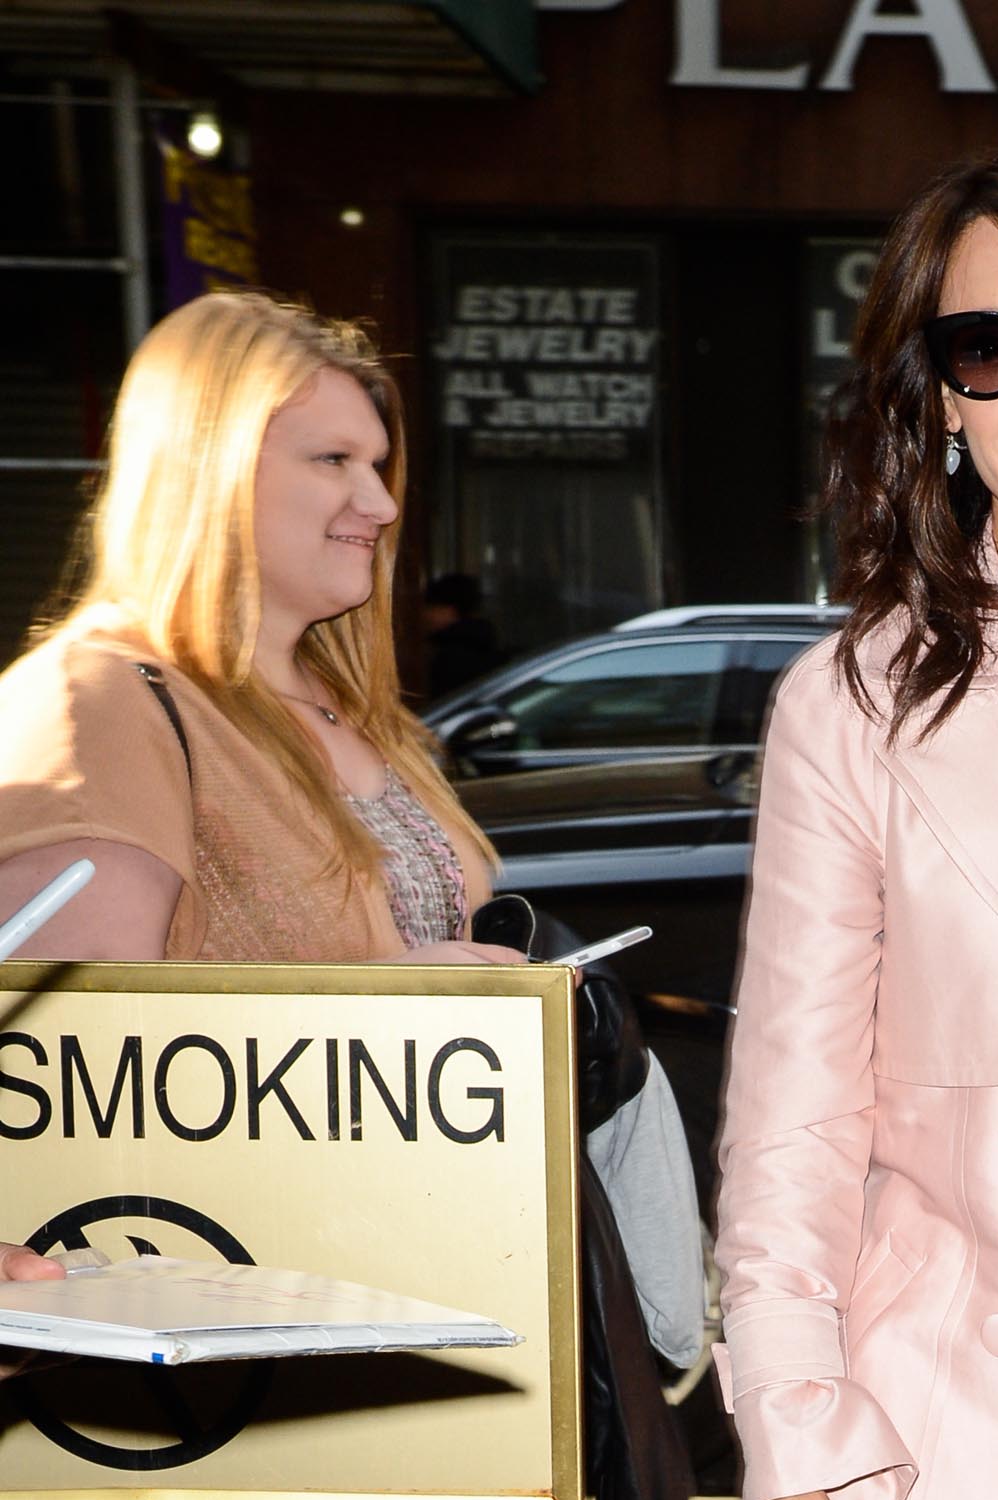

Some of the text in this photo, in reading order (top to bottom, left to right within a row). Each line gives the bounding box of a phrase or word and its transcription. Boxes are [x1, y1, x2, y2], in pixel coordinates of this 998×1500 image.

[458, 285, 639, 323] ESTATE
[433, 325, 660, 363] JEWELRY
[446, 371, 653, 402] ALL WATCH
[485, 400, 653, 428] JEWELRY
[0, 1031, 506, 1144] SMOKING
